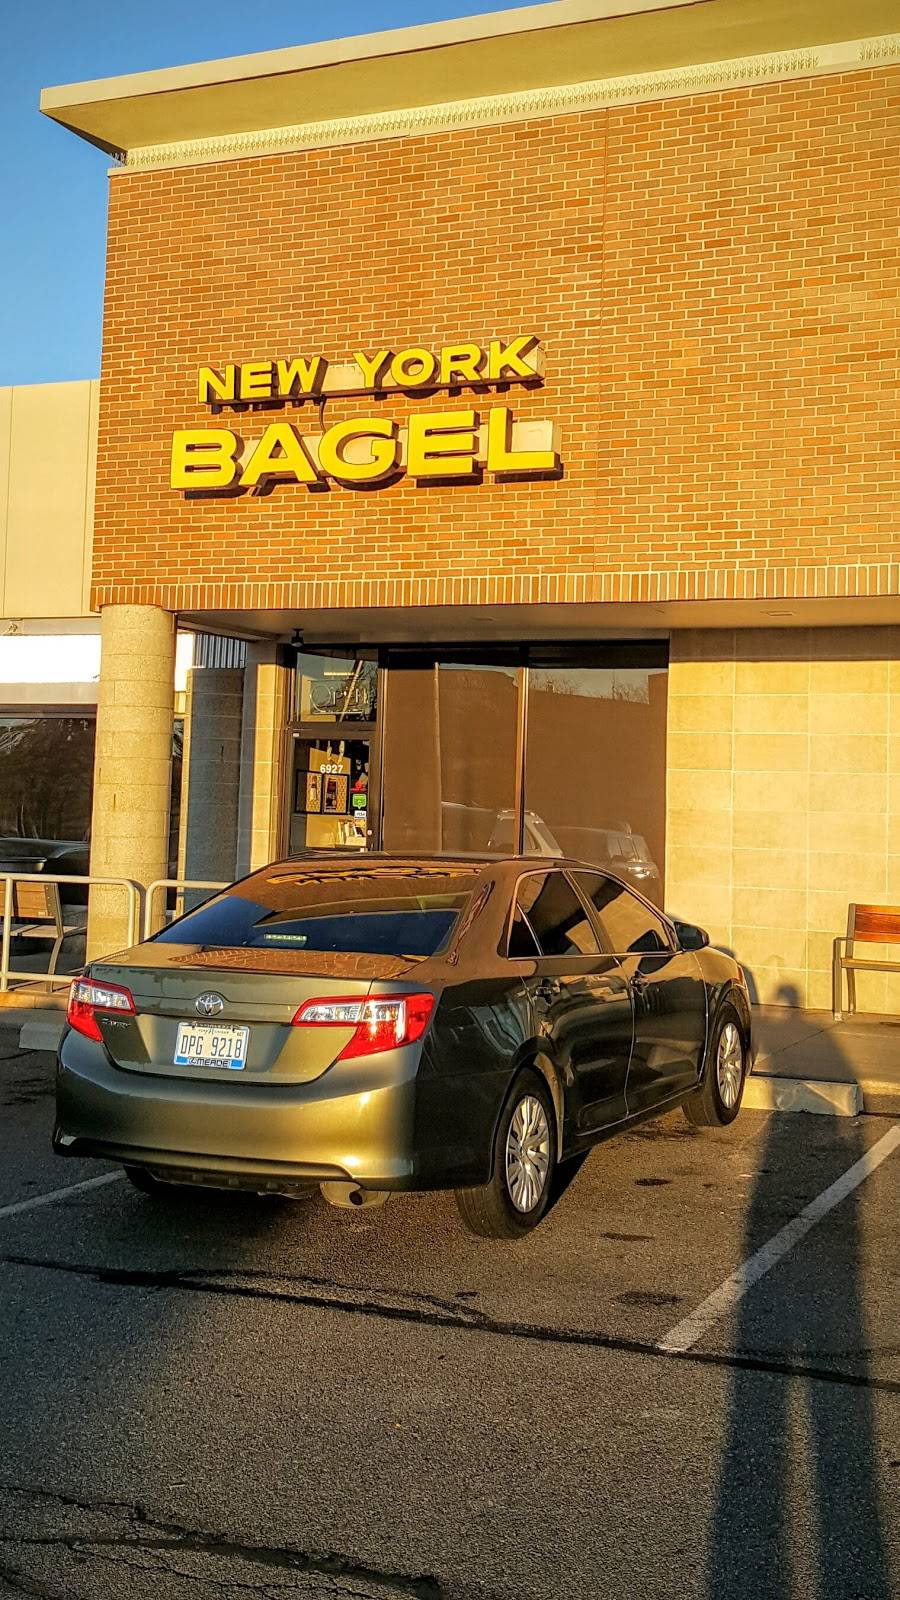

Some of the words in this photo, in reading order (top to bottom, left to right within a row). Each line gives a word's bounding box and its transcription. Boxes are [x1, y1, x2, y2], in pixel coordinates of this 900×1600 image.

[199, 356, 323, 403] NEW
[354, 335, 537, 389] YORK
[170, 407, 555, 490] BAGEL
[320, 764, 344, 774] 6927
[181, 1034, 204, 1056] DPG
[211, 1036, 243, 1059] 9218
